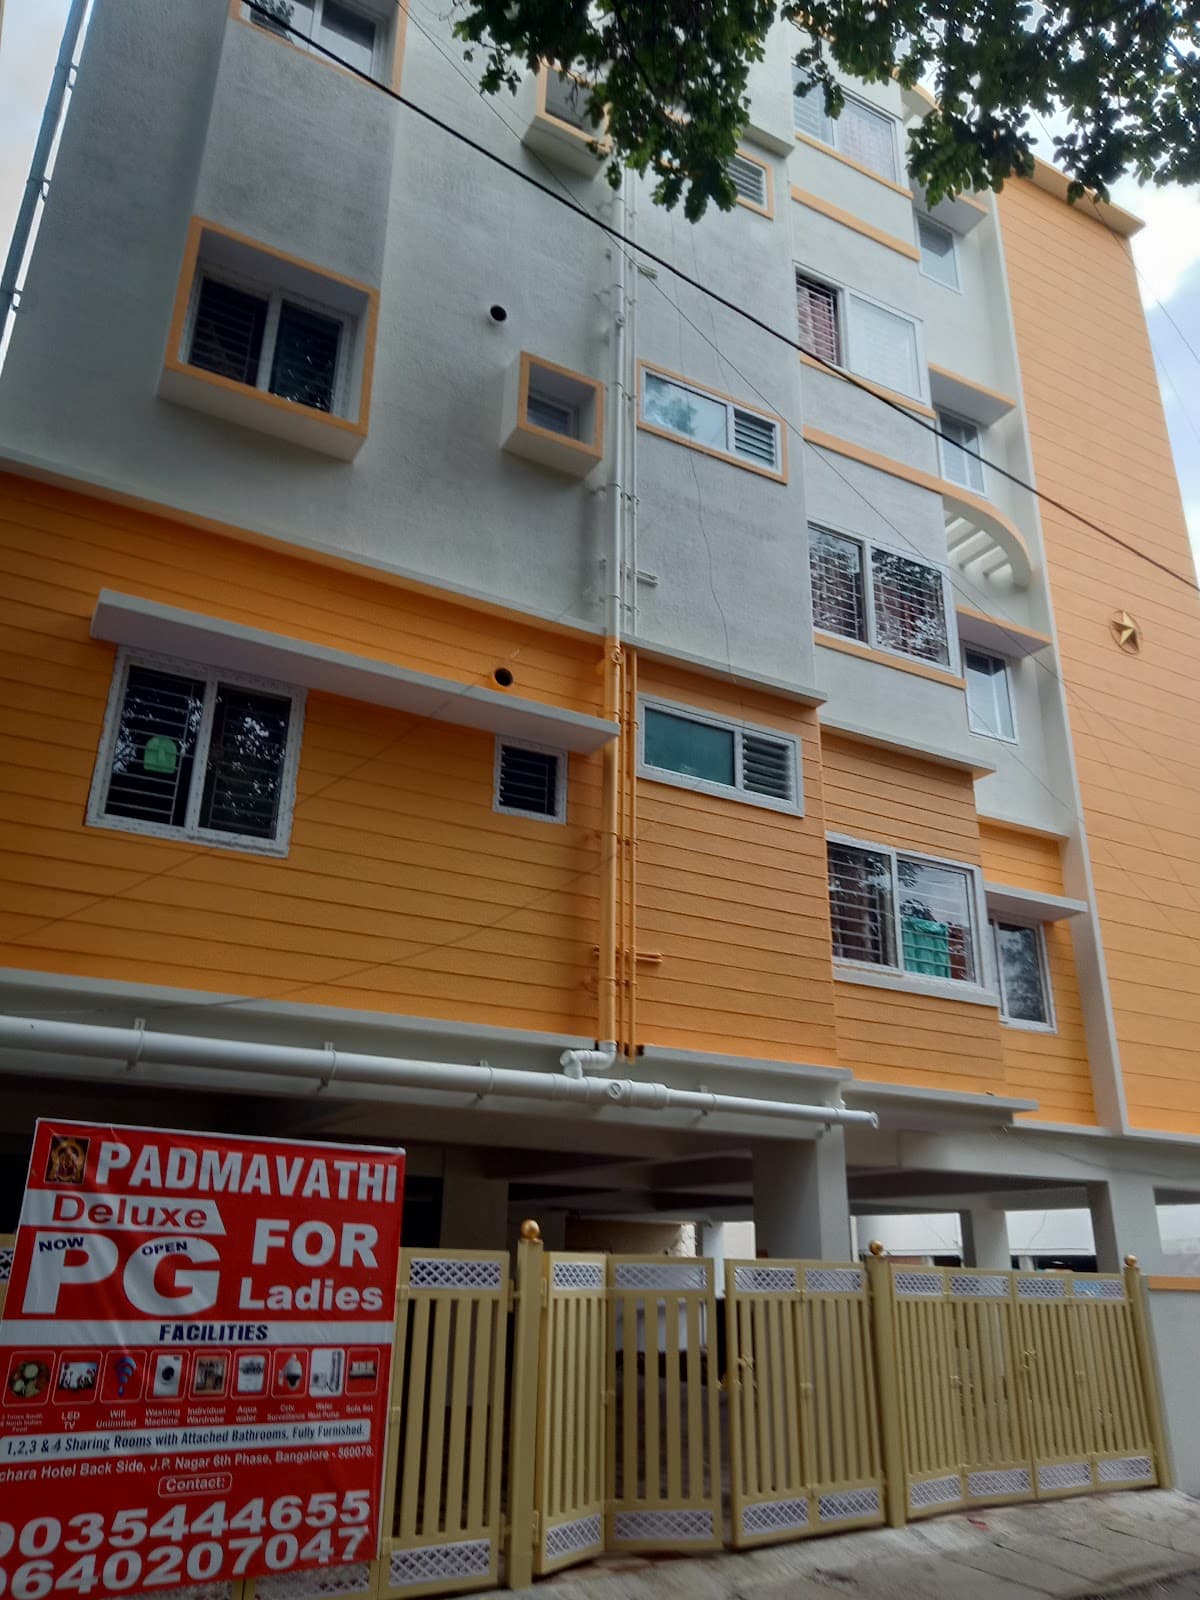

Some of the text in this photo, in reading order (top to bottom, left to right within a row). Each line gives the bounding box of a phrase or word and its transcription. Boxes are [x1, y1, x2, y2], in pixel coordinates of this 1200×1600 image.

[95, 1141, 397, 1204] PADMAVATHI
[52, 1194, 208, 1230] Deluxe
[38, 1237, 188, 1257] NOW OPEN
[251, 1218, 379, 1268] FOR
[21, 1231, 221, 1317] PG
[239, 1277, 384, 1311] Ladies
[158, 1323, 269, 1342] FACILITIES
[61, 1411, 80, 1421] LED
[63, 1421, 76, 1430] TV
[96, 1418, 137, 1429] Unlimited
[144, 1417, 179, 1426] Machine
[145, 1408, 180, 1418] Washing
[7, 1439, 37, 1456] 1,2,3
[41, 1439, 49, 1453] &
[52, 1437, 62, 1452] 4
[64, 1437, 110, 1453] Sharing
[113, 1435, 152, 1449] Rooms
[155, 1432, 178, 1446] with
[181, 1430, 229, 1444] Attached
[292, 1424, 315, 1440] Fully
[41, 1464, 77, 1479] Hotel
[80, 1461, 112, 1476] Back
[175, 1456, 210, 1471] Nagar
[213, 1454, 231, 1467] 6th
[275, 1448, 329, 1464] Bangalore
[165, 1476, 226, 1493] Contact:
[0, 1525, 370, 1600] 640207047
